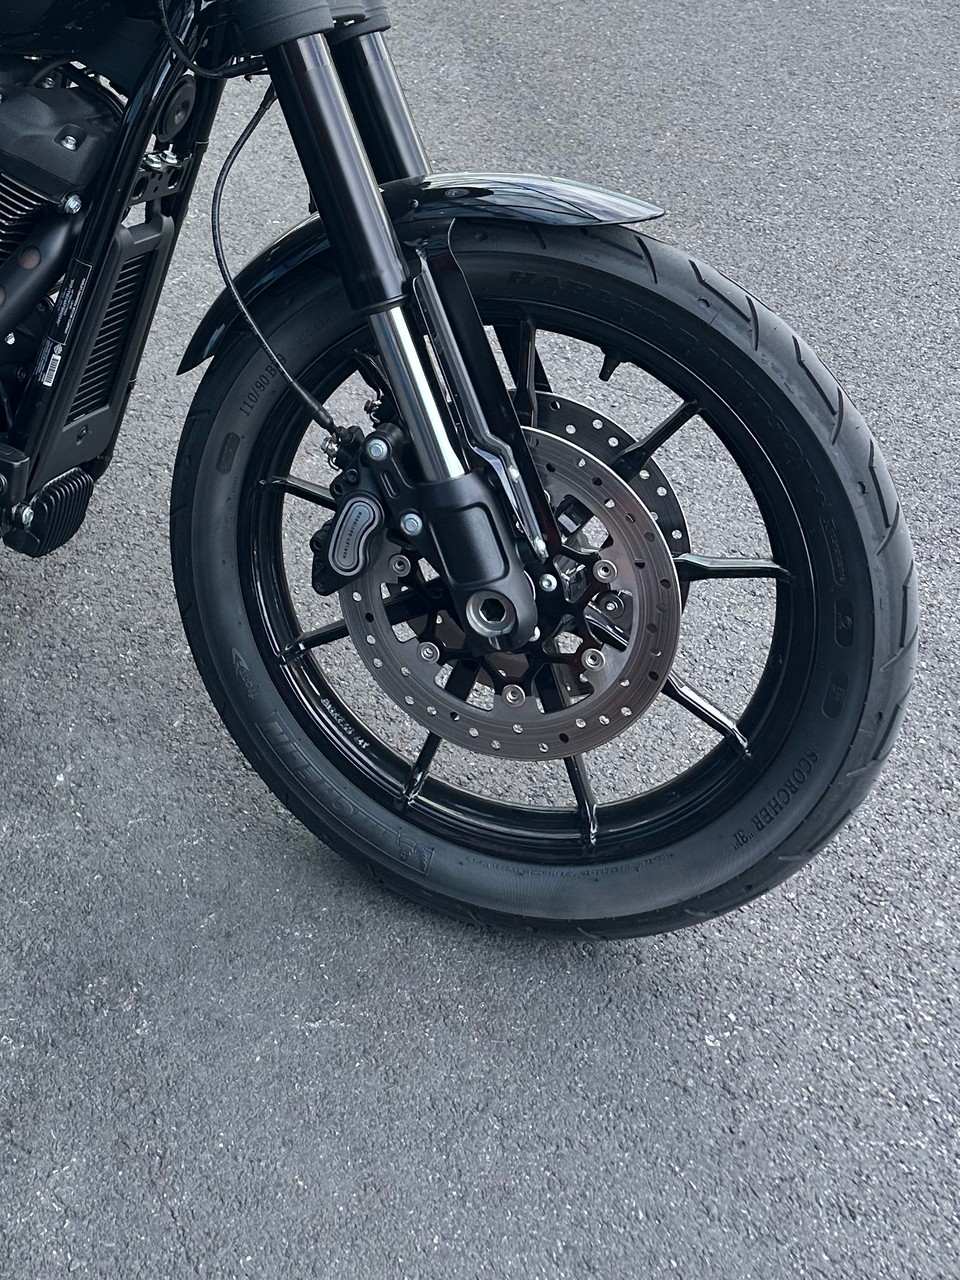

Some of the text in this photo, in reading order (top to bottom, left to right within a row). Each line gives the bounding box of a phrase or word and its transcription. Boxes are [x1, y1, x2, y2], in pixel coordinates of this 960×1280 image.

[240, 372, 271, 418] 110/90
[264, 353, 287, 378] B9
[752, 747, 819, 832] SCORCHER
